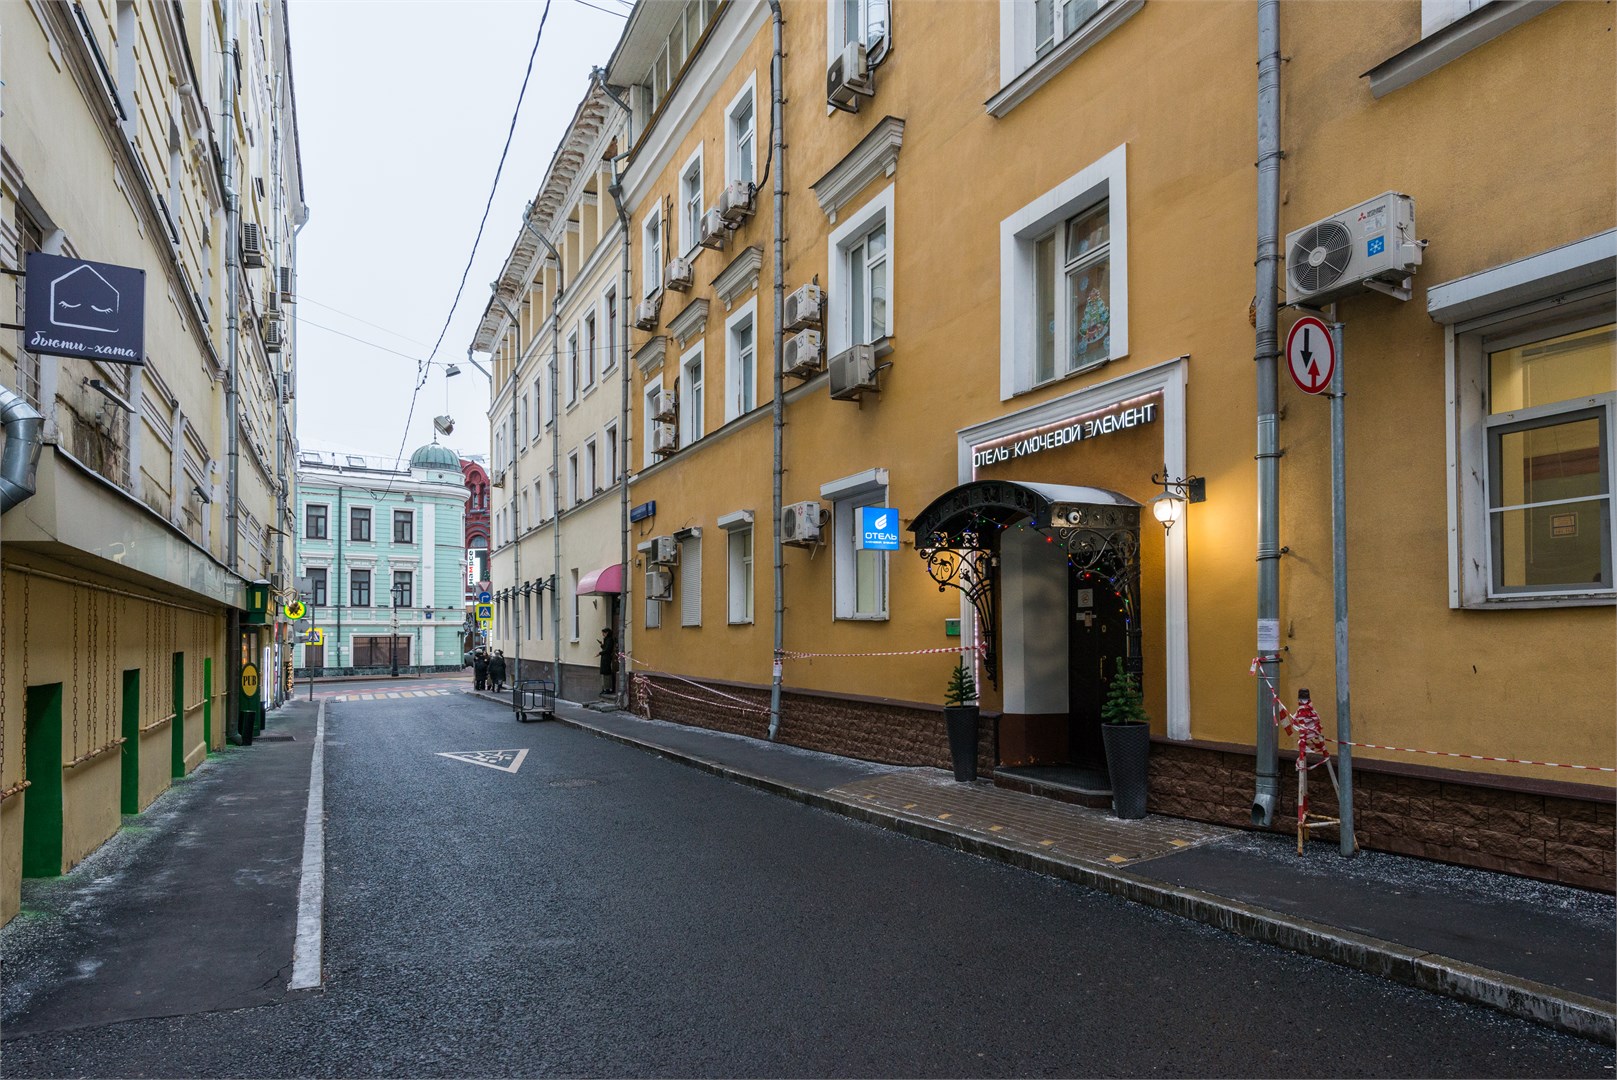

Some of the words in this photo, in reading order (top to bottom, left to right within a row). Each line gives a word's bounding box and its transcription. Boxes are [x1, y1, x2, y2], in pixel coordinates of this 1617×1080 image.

[31, 331, 137, 357] бьюти-хата
[973, 445, 1010, 468] ОТЕЛЬ
[1013, 423, 1081, 457] КЛЮЧЕВОЙ
[1084, 403, 1155, 439] ЭЛЕМЕНТ
[865, 532, 897, 541] ОТЕЛЬ
[243, 675, 257, 687] PUB
